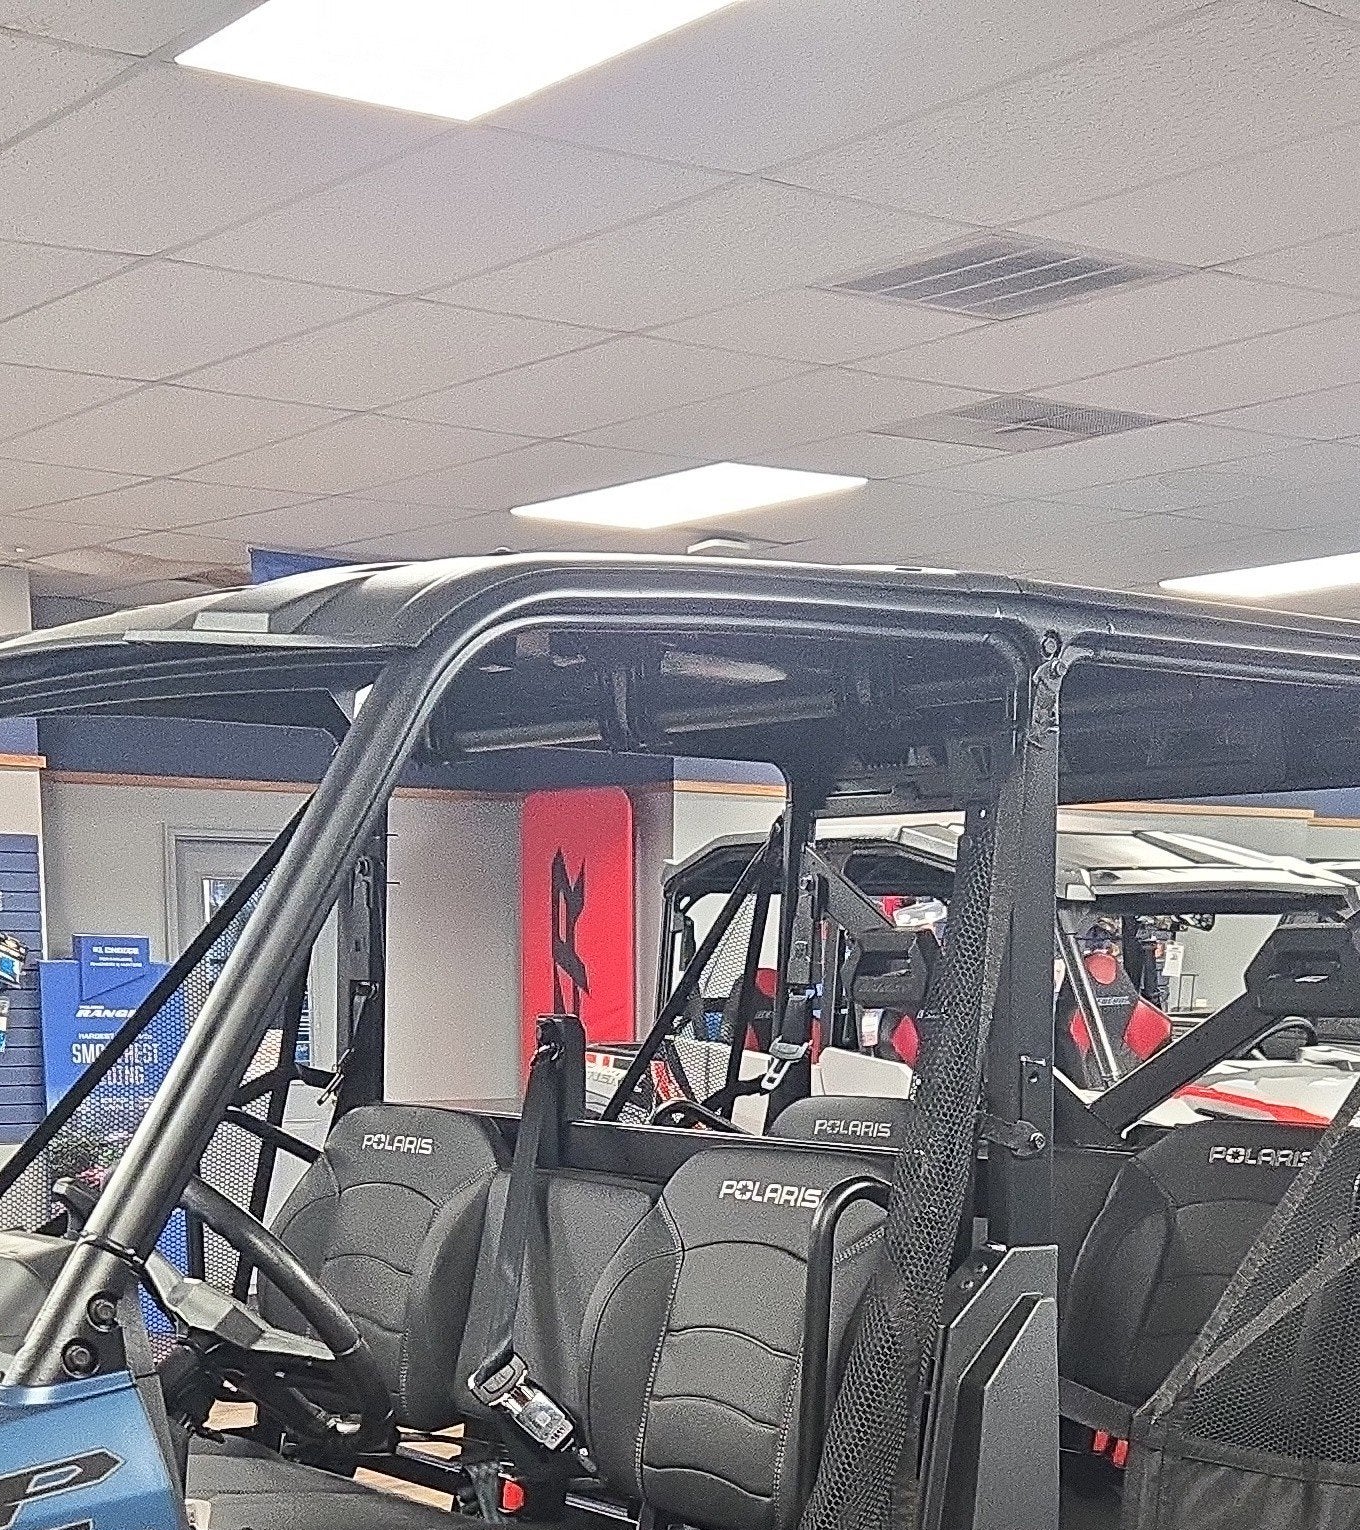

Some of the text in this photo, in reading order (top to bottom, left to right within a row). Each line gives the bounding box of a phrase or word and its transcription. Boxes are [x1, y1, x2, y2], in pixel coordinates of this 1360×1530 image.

[71, 1042, 160, 1064] SMOHEST
[813, 1119, 892, 1138] POLARIS
[361, 1133, 435, 1156] POLARIS
[1208, 1146, 1313, 1168] POLARIS
[718, 1180, 824, 1210] POLARIS
